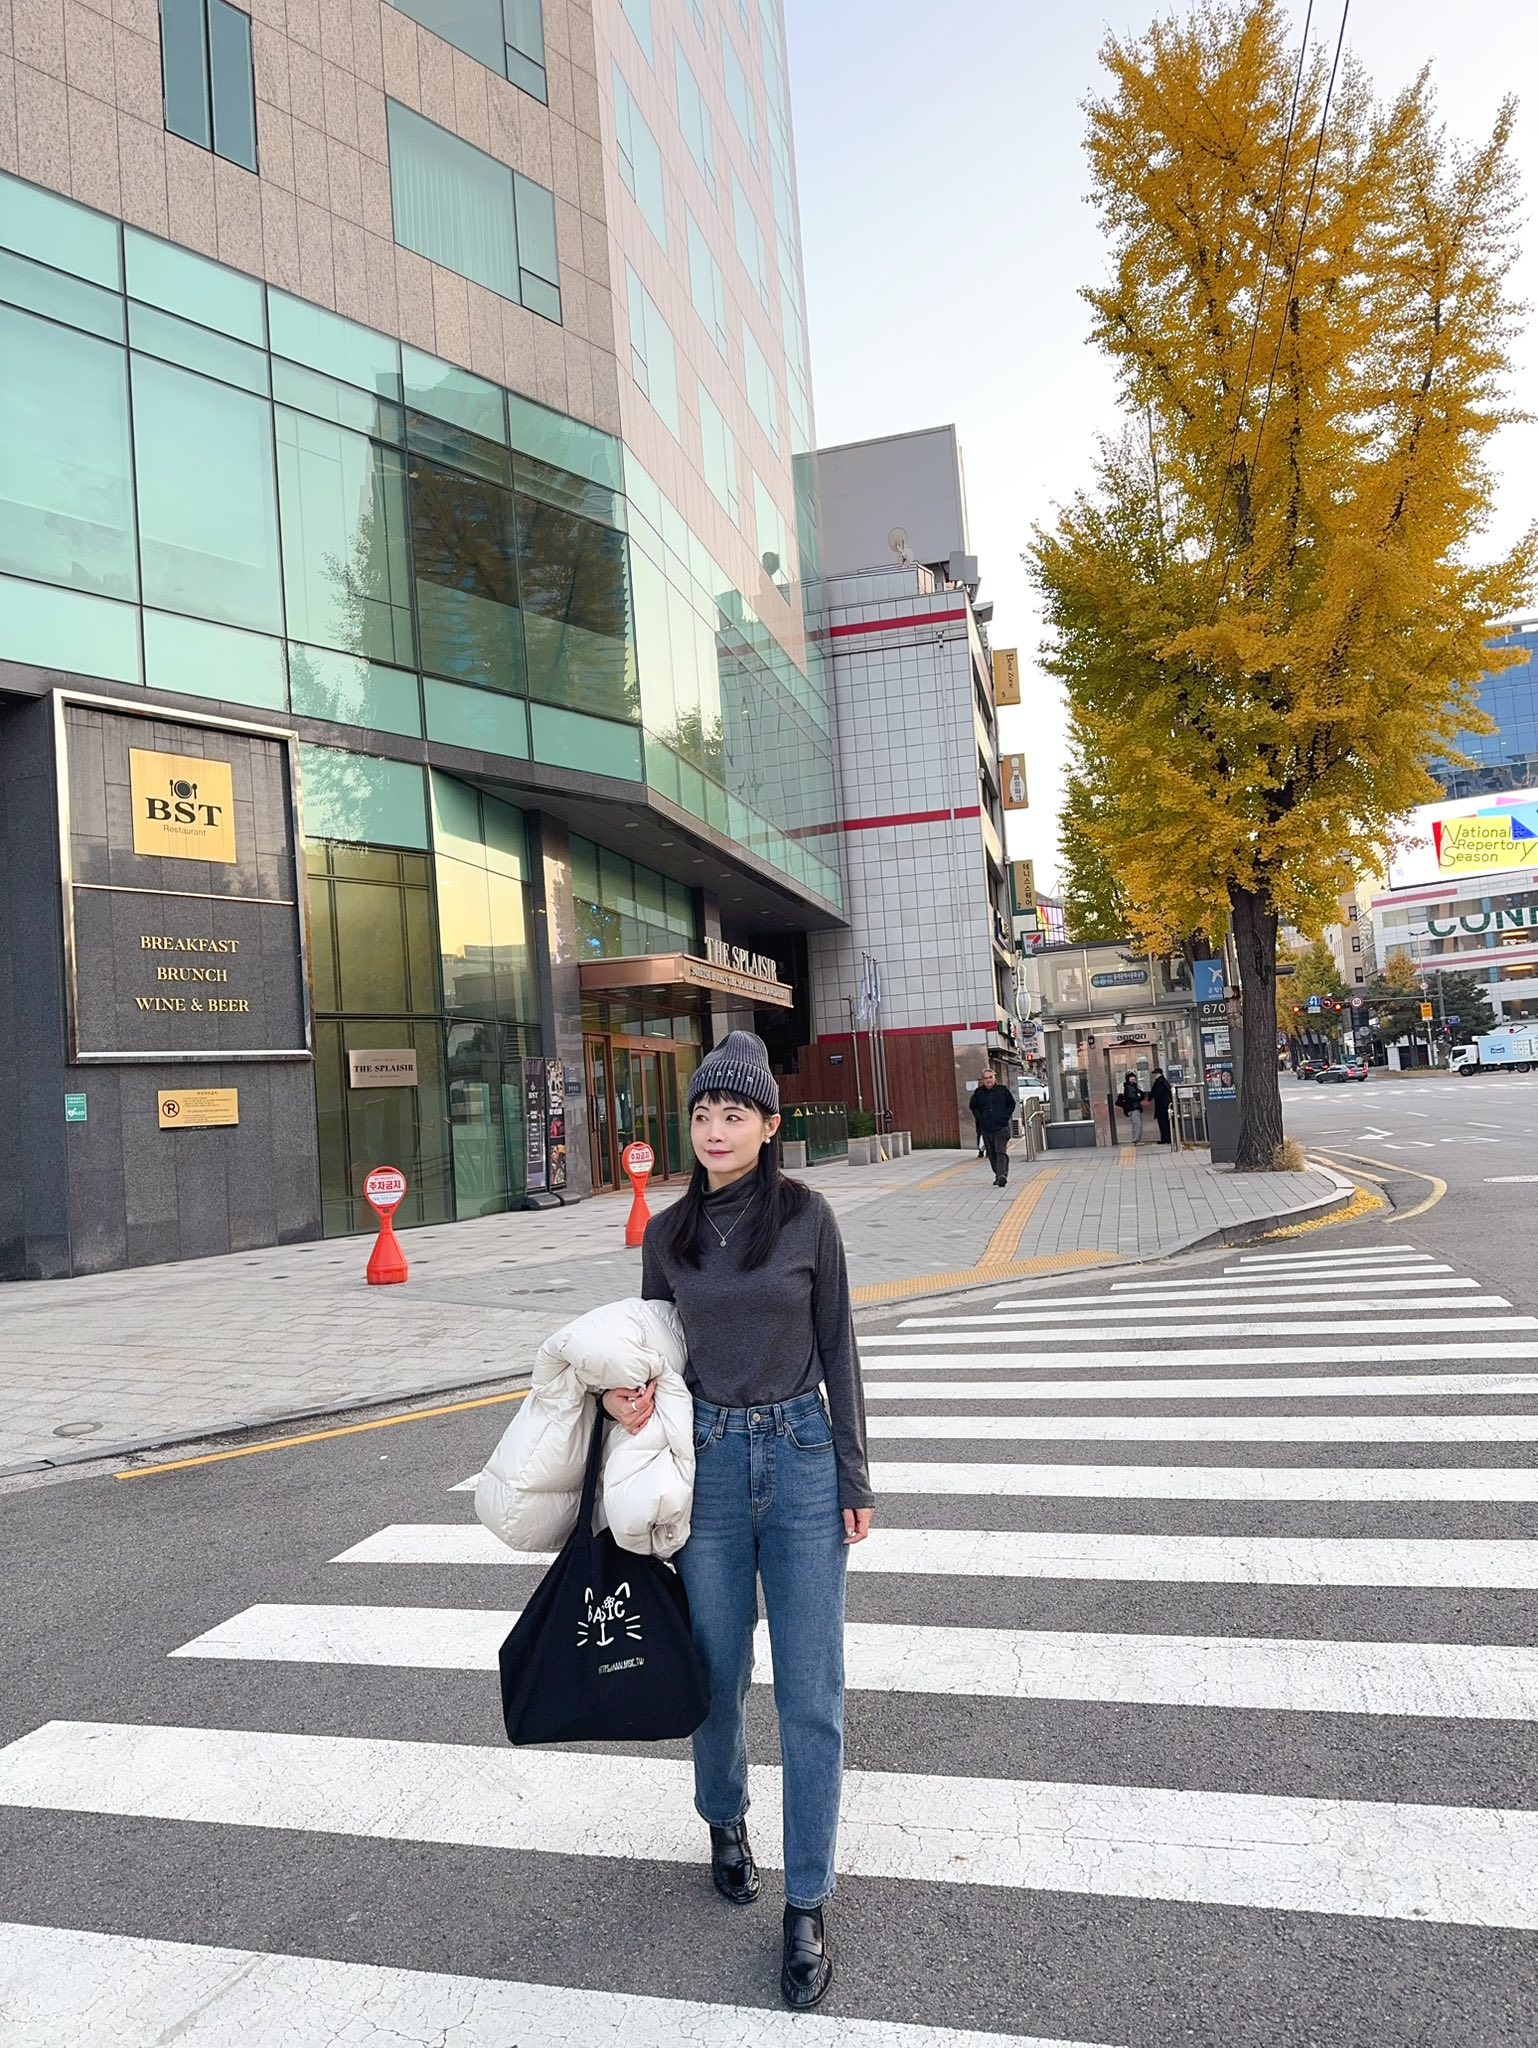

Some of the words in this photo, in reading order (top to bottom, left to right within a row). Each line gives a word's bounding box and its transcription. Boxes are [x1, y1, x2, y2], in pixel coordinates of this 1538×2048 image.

[145, 797, 222, 827] BST
[163, 824, 207, 837] Restaurant
[1440, 824, 1512, 845] National
[1439, 845, 1498, 867] Season
[1457, 839, 1538, 863] Repertory
[140, 935, 240, 953] BREAKFAST
[703, 936, 730, 968] THE
[731, 945, 779, 982] SPLAISIR
[156, 966, 228, 982] BRUNCH
[134, 997, 186, 1011] WINE
[190, 997, 204, 1012] &
[208, 998, 250, 1012] BEER
[1202, 1002, 1226, 1014] 670
[353, 1065, 373, 1073] THE
[374, 1063, 414, 1073] SPLAISIR
[369, 1179, 401, 1191] 주차금지
[587, 1599, 626, 1623] BASIC
